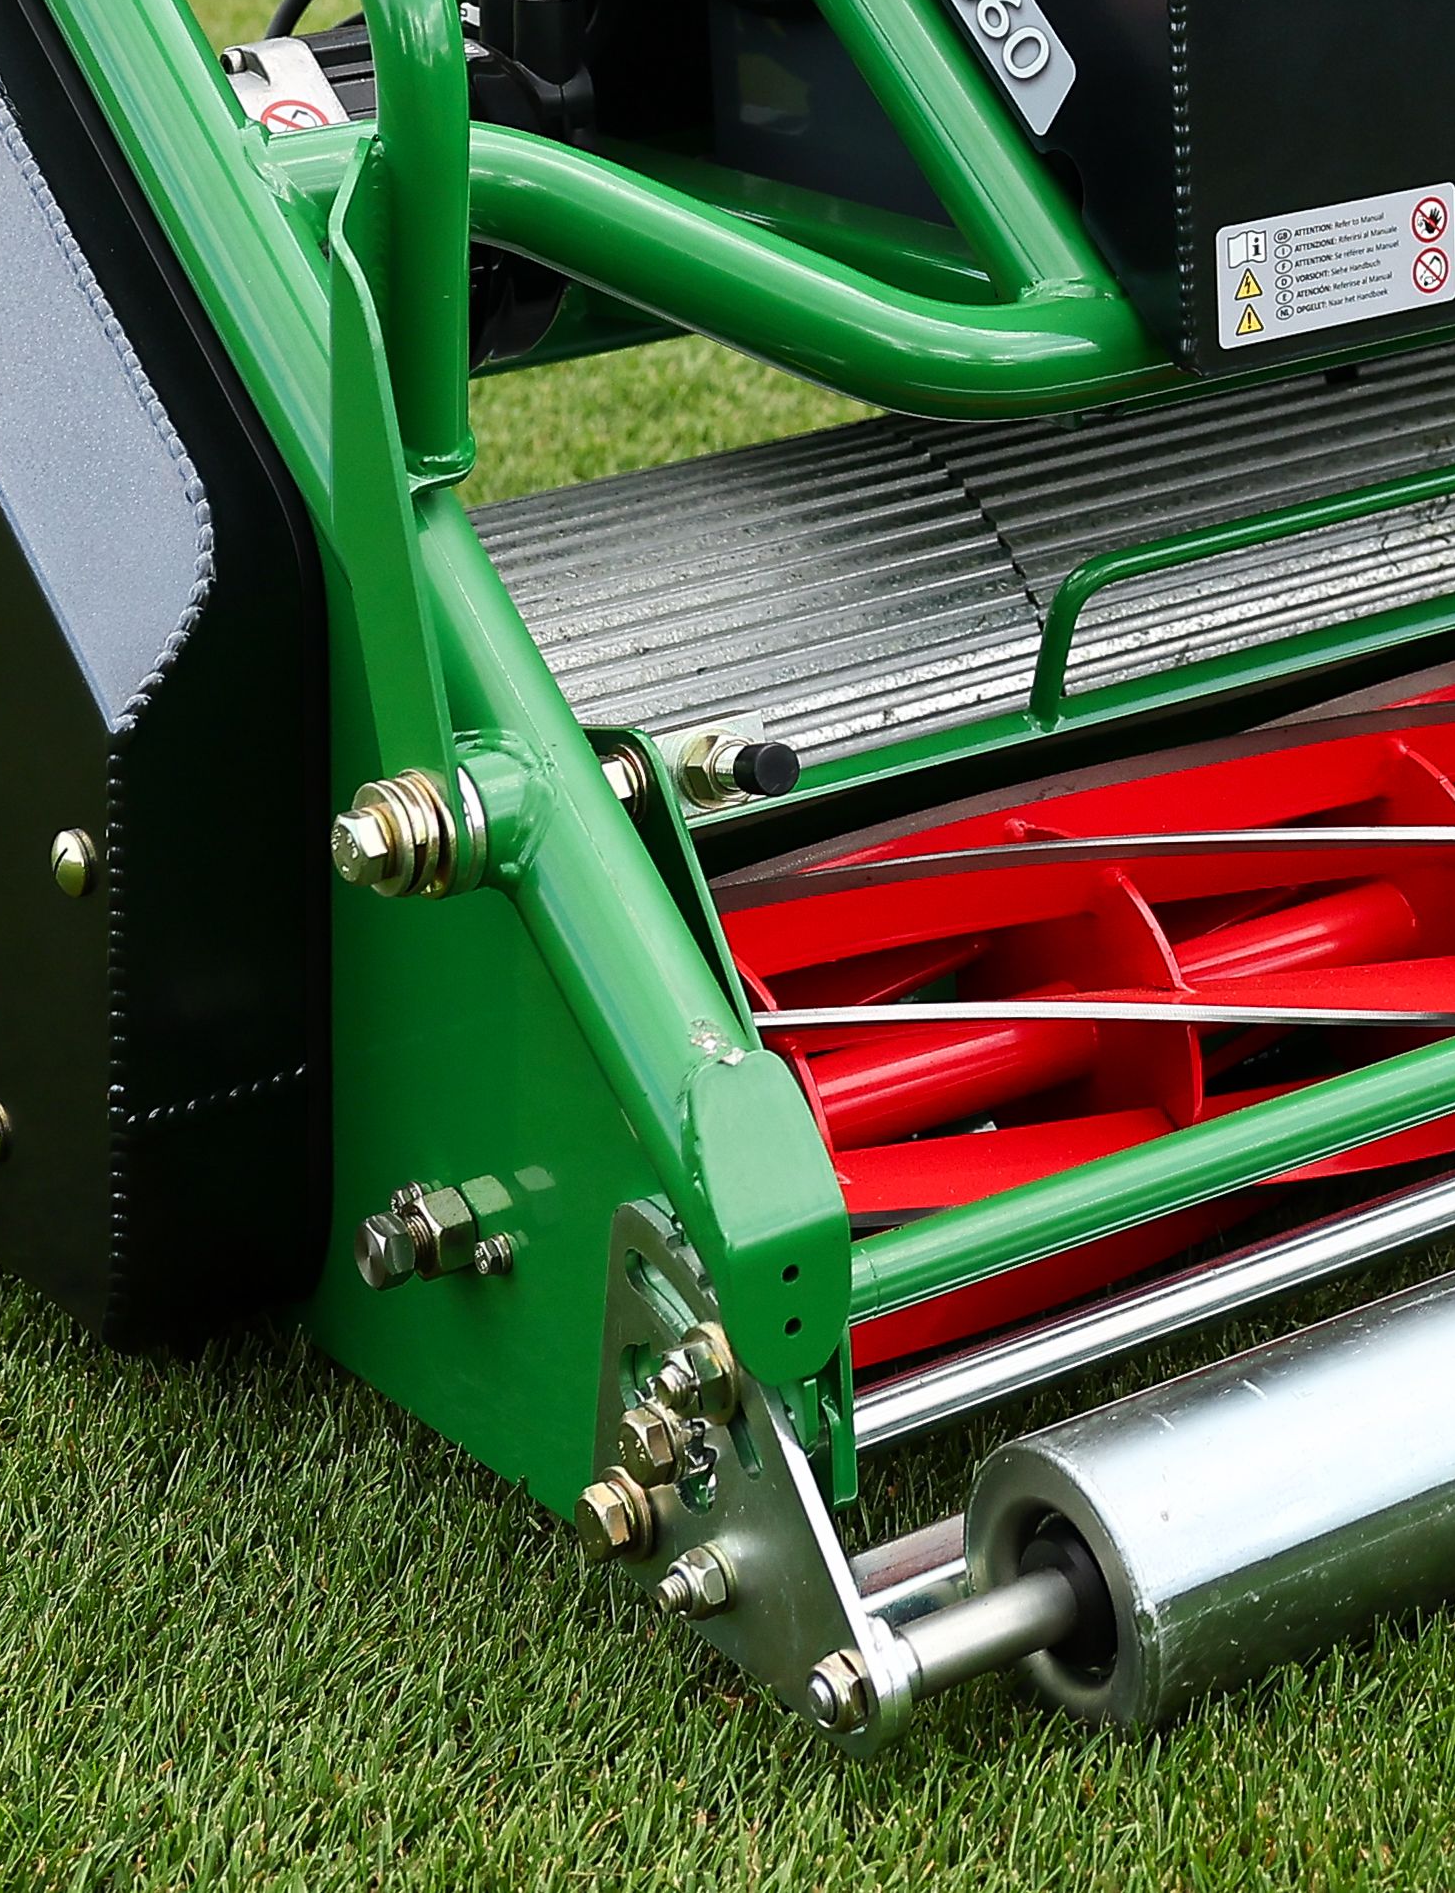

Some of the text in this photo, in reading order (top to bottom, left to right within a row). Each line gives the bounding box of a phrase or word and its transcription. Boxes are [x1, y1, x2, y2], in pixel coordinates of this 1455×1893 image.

[1294, 224, 1333, 237] ATTENTION:
[1361, 213, 1384, 224] Manual
[1295, 254, 1334, 267] ATTENTION:
